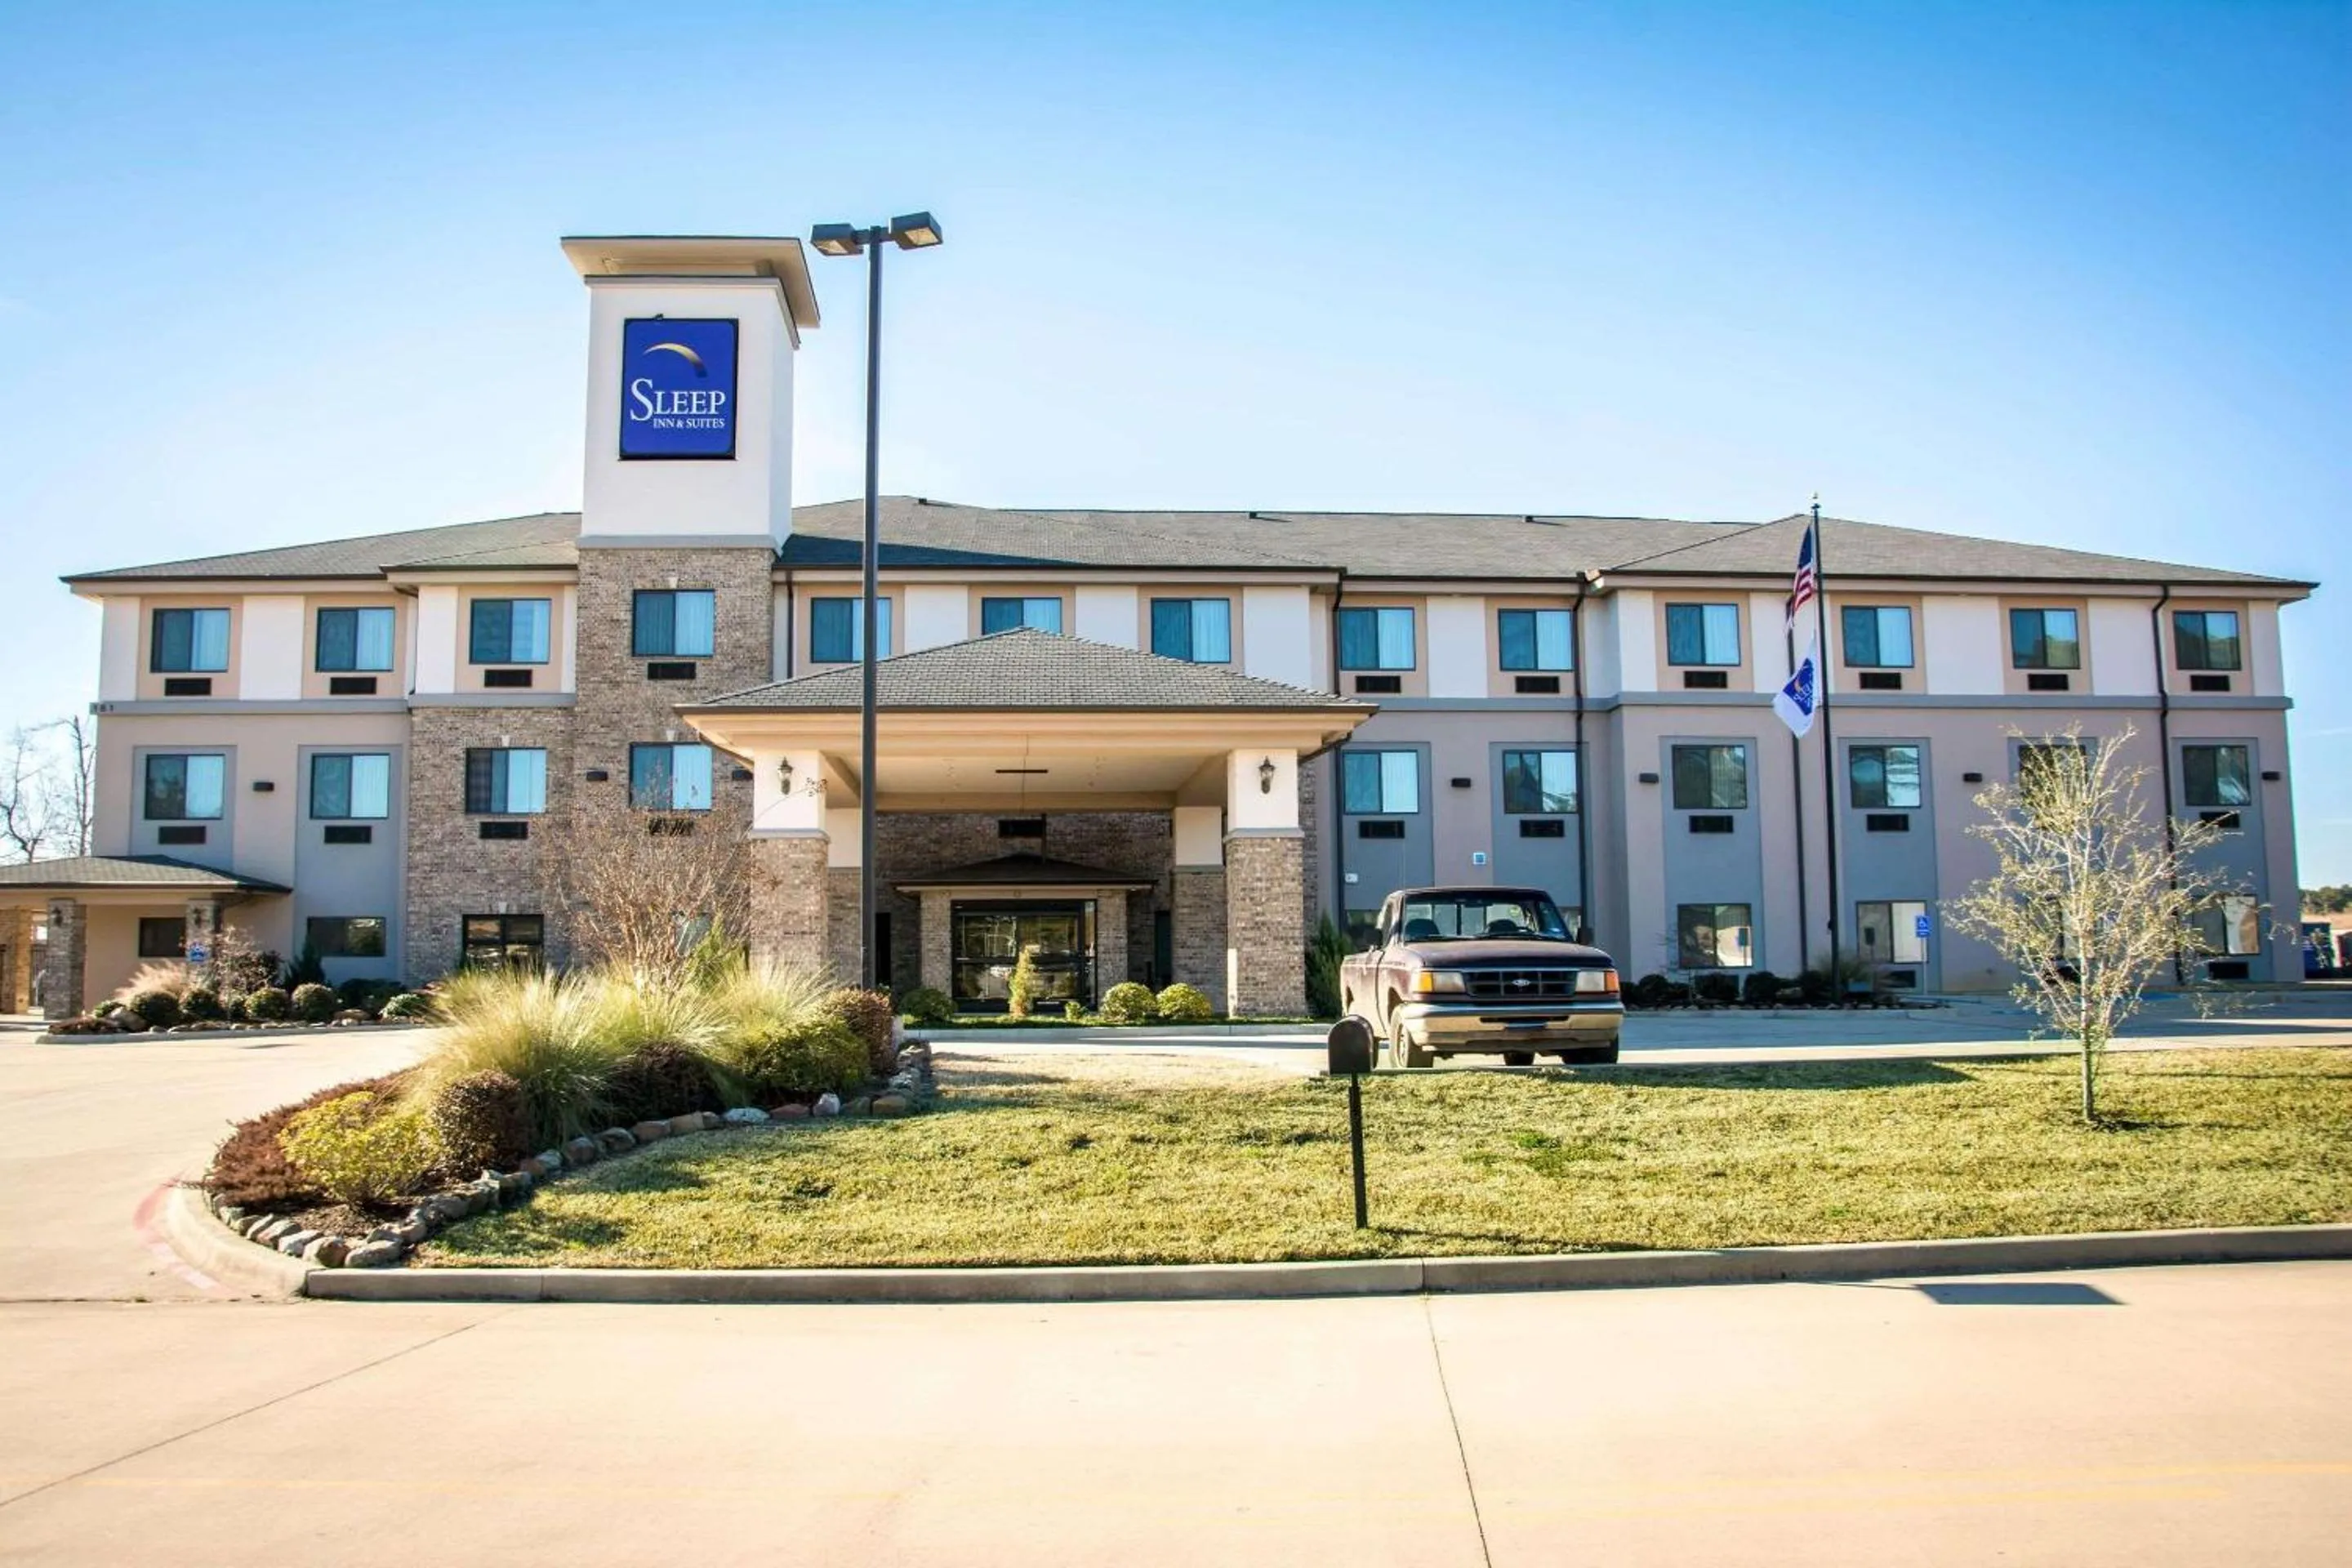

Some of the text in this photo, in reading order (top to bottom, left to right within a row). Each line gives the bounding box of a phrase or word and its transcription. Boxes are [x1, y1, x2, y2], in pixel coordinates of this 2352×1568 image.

[630, 378, 726, 421] SLEEP
[653, 418, 725, 429] INN & SUITES
